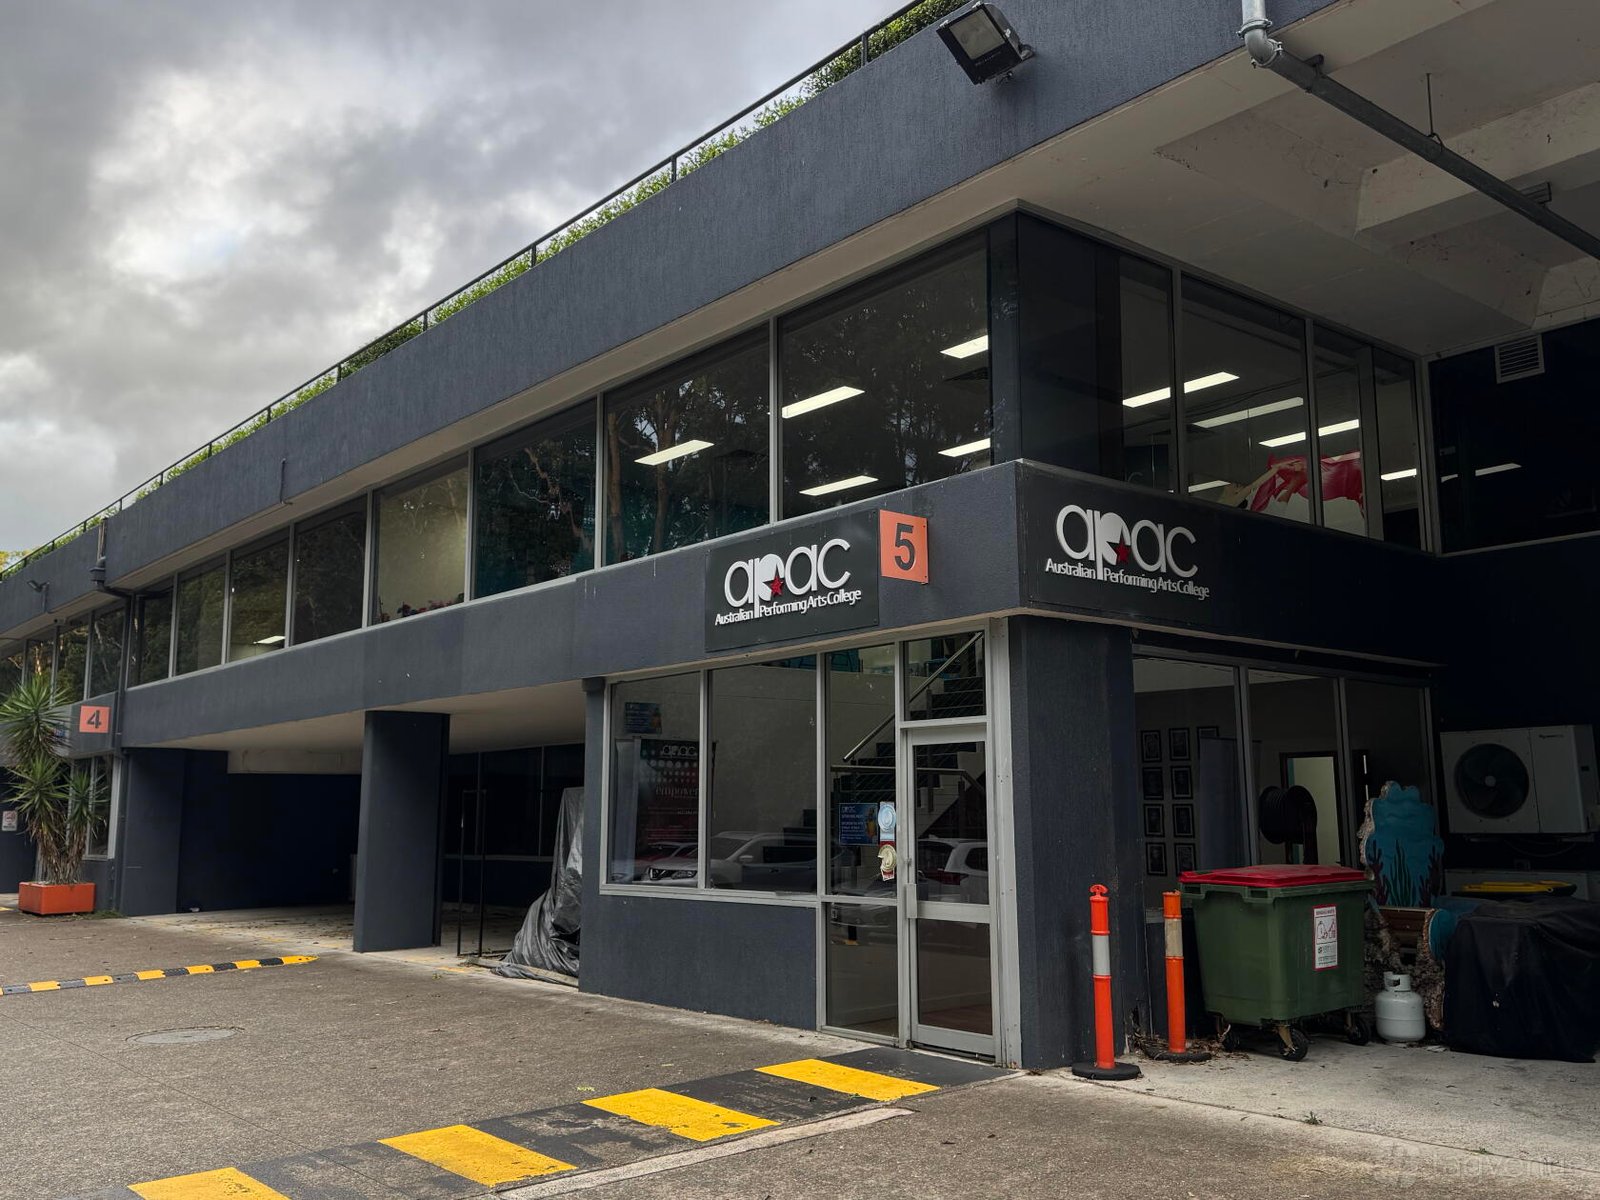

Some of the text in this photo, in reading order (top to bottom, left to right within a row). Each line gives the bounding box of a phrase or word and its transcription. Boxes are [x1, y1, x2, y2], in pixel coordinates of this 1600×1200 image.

[894, 522, 915, 570] 5
[1056, 504, 1198, 580] apac
[724, 538, 851, 619] apac
[1045, 558, 1210, 600] Australian Performing Arts College
[715, 589, 862, 626] Australian Performing Arts College
[87, 709, 102, 729] 4
